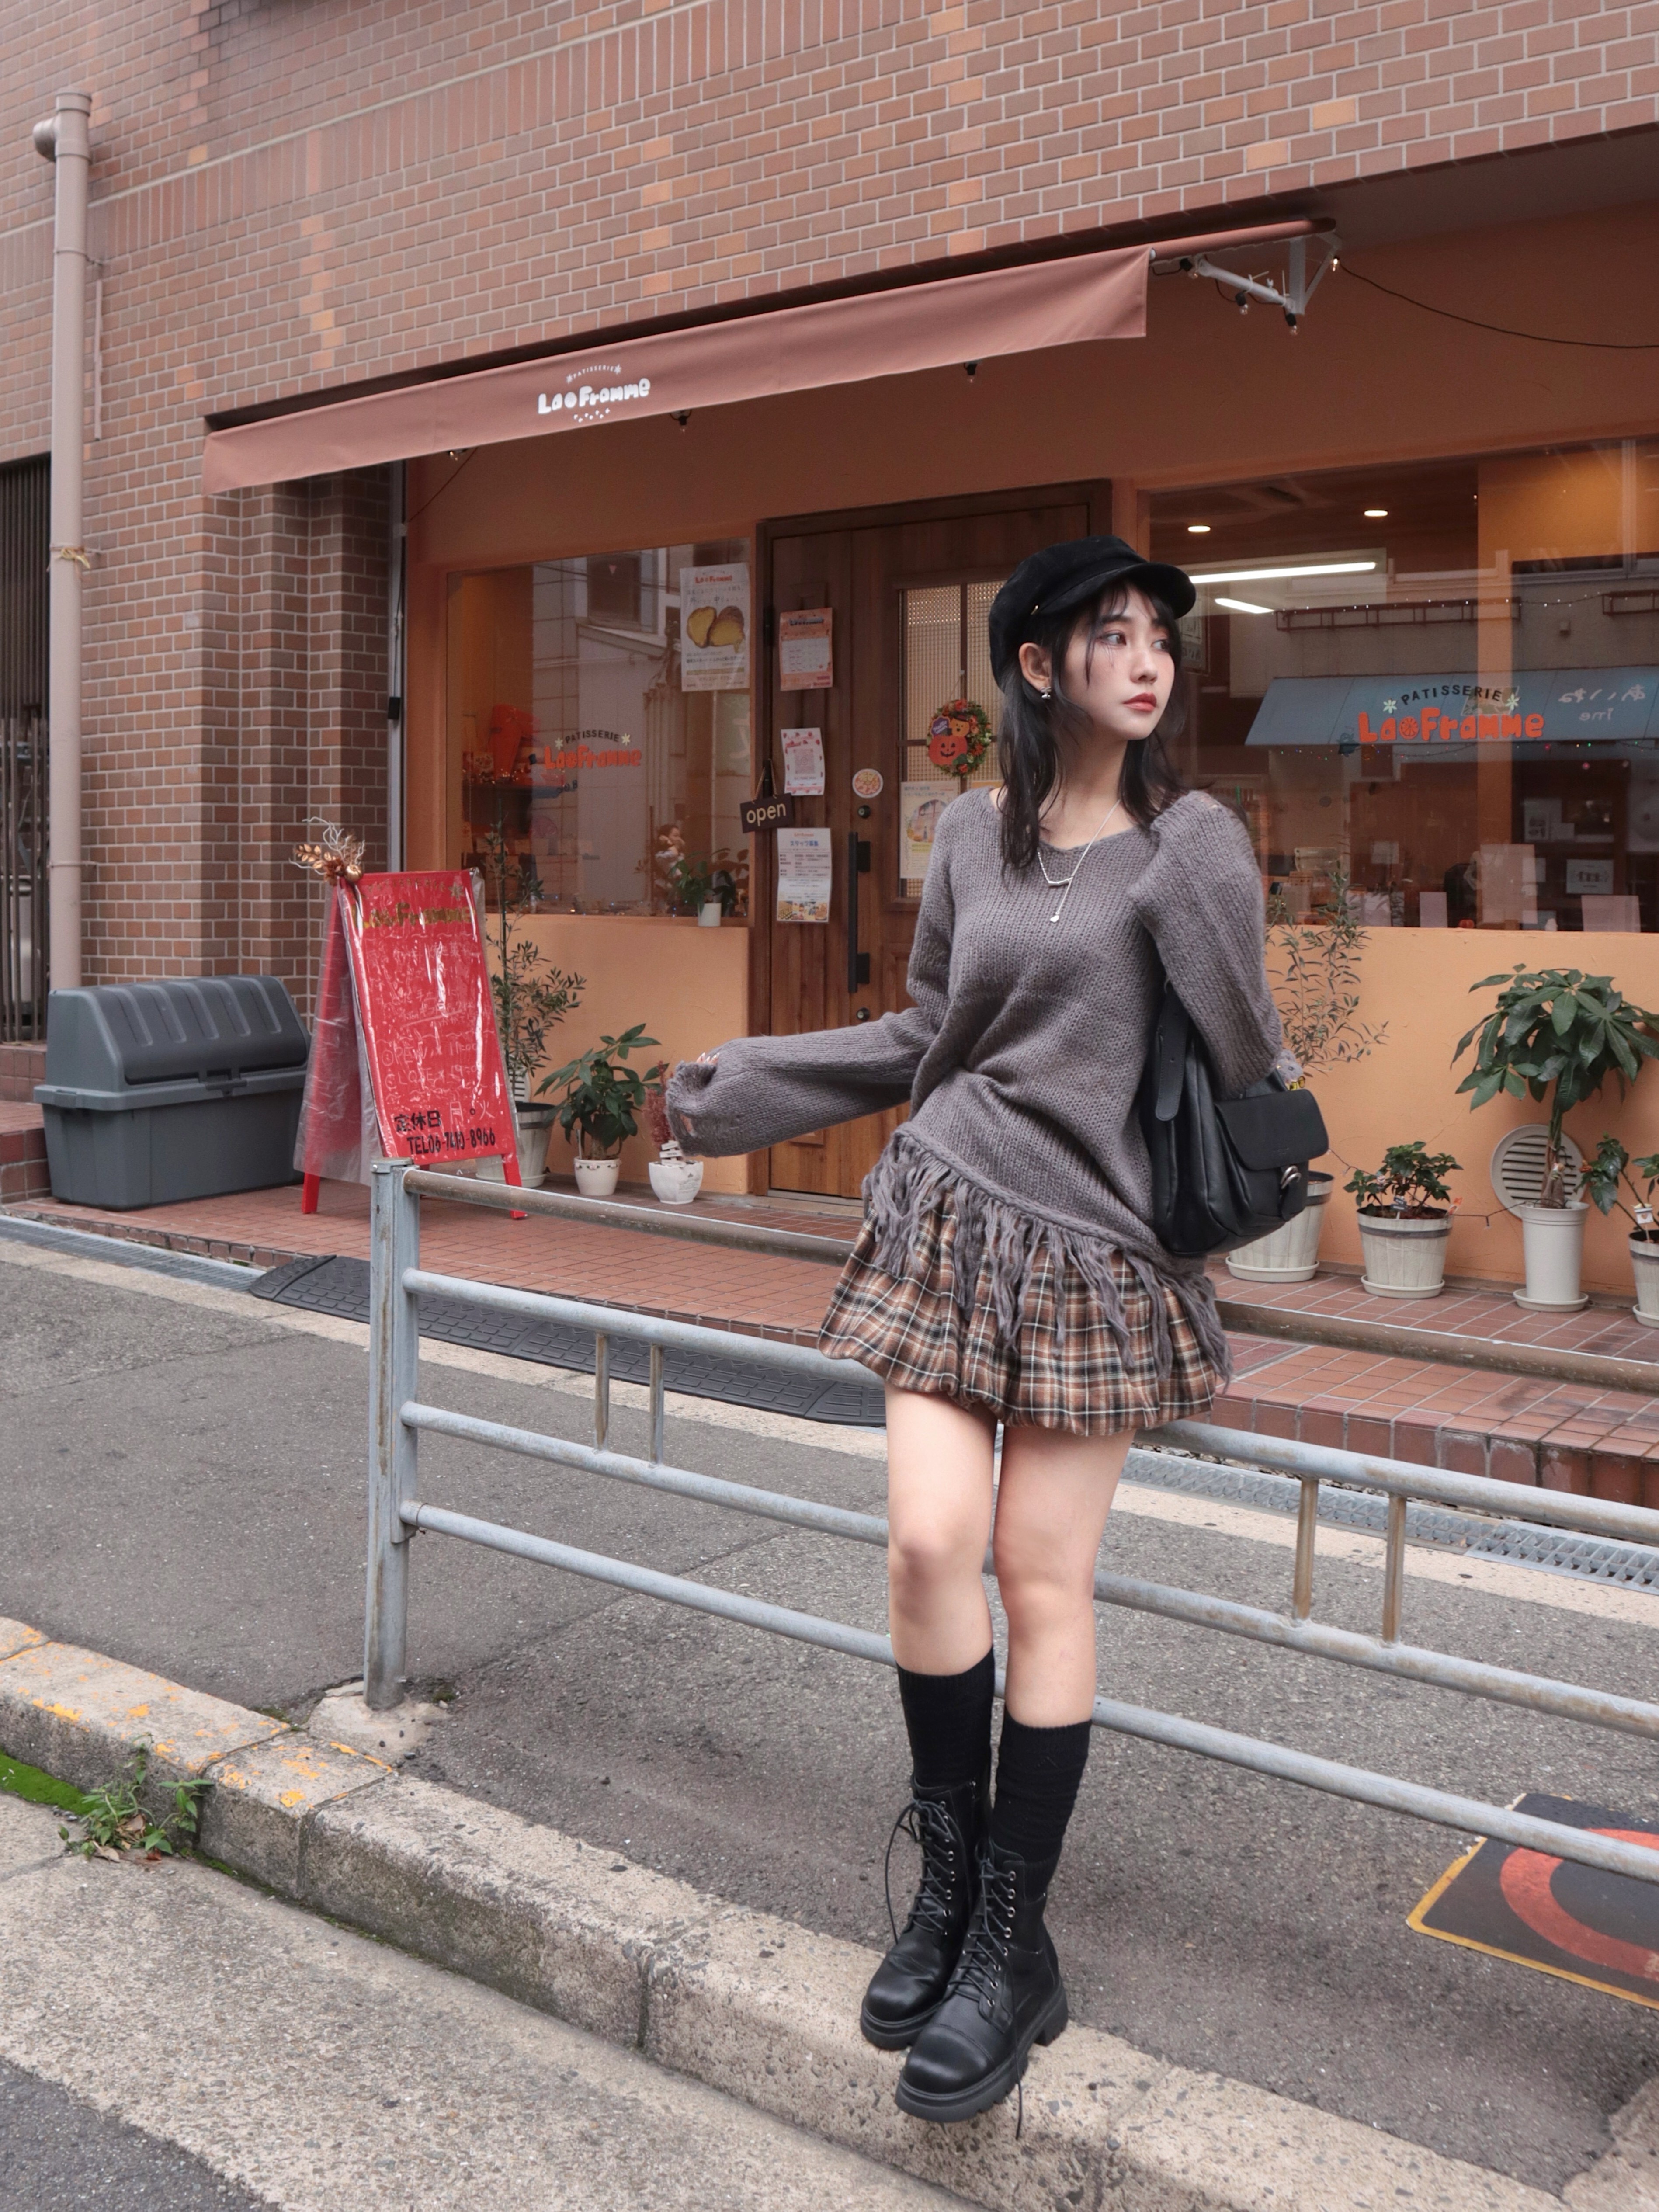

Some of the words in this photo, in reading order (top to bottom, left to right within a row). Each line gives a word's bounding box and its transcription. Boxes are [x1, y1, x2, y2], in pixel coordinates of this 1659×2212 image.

[573, 365, 614, 379] PATISSERIE
[1401, 685, 1502, 705] PATISSERIE
[565, 729, 620, 743] PATISSERIE
[746, 803, 786, 826] open
[394, 1110, 441, 1132] 定休日
